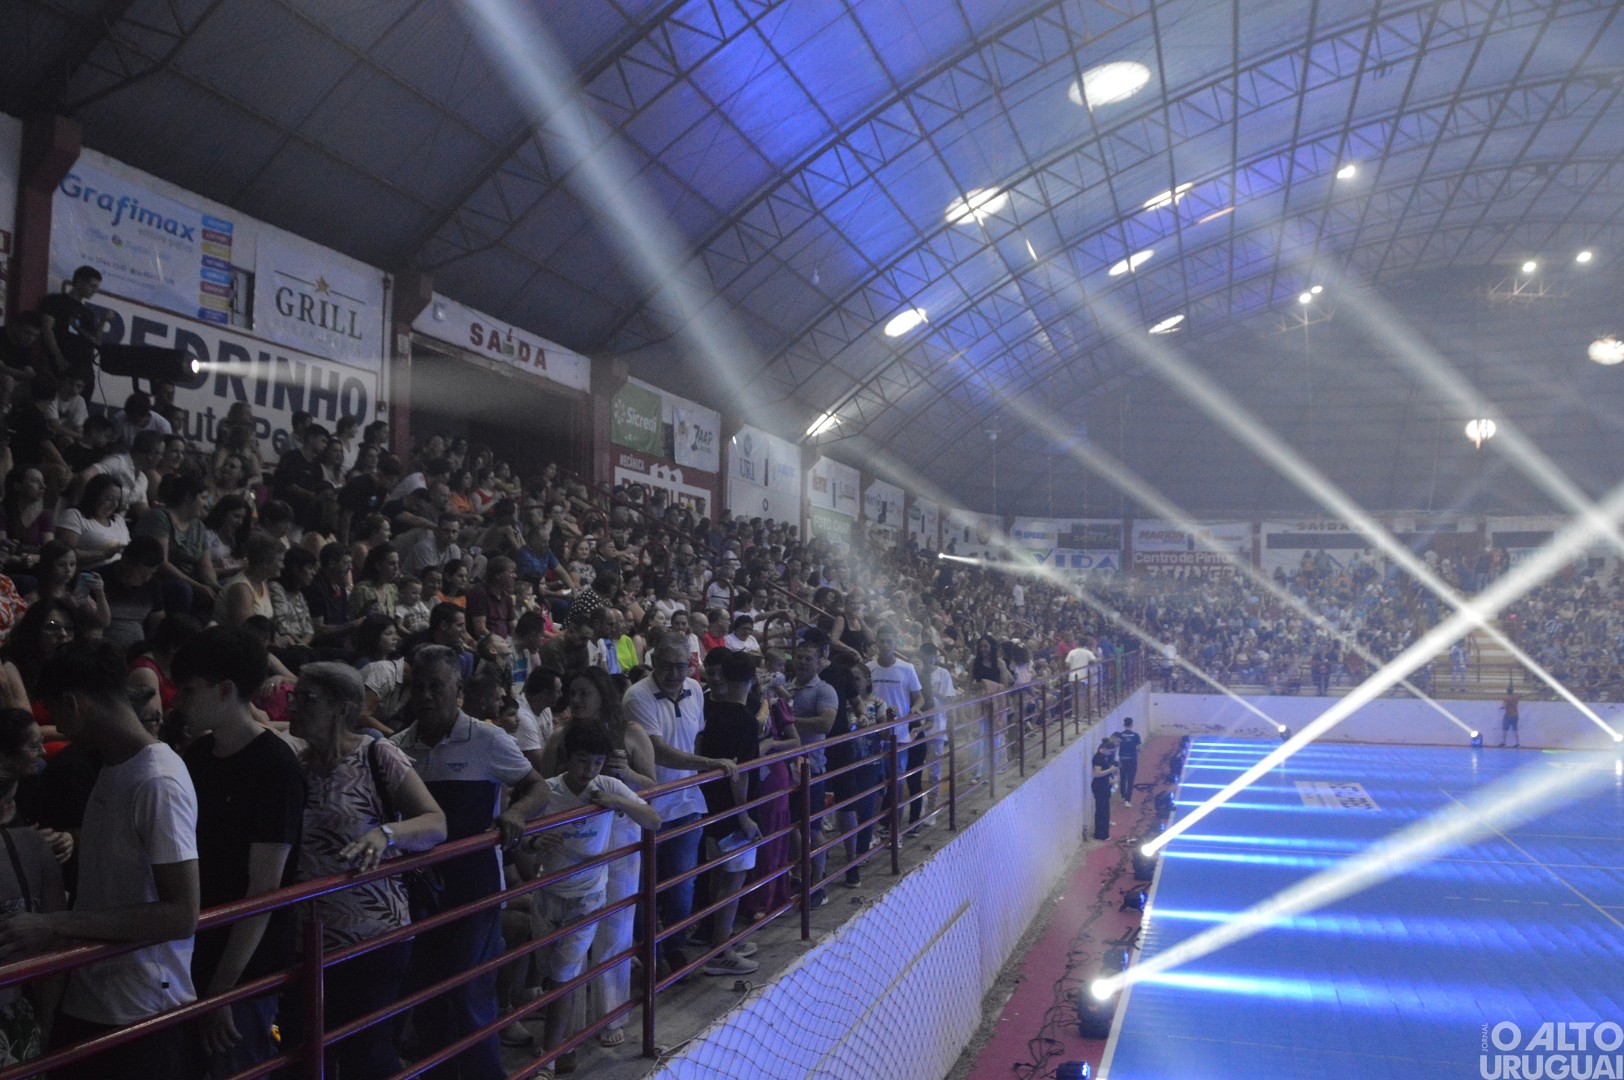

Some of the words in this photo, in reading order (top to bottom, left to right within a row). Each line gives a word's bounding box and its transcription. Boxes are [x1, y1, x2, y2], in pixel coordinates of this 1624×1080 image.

[60, 172, 196, 242] Grafimax
[275, 286, 362, 340] GRILL
[626, 406, 657, 434] Sicredi
[1032, 548, 1118, 573] VIDA
[1134, 552, 1178, 563] Centro
[1179, 552, 1195, 563] de
